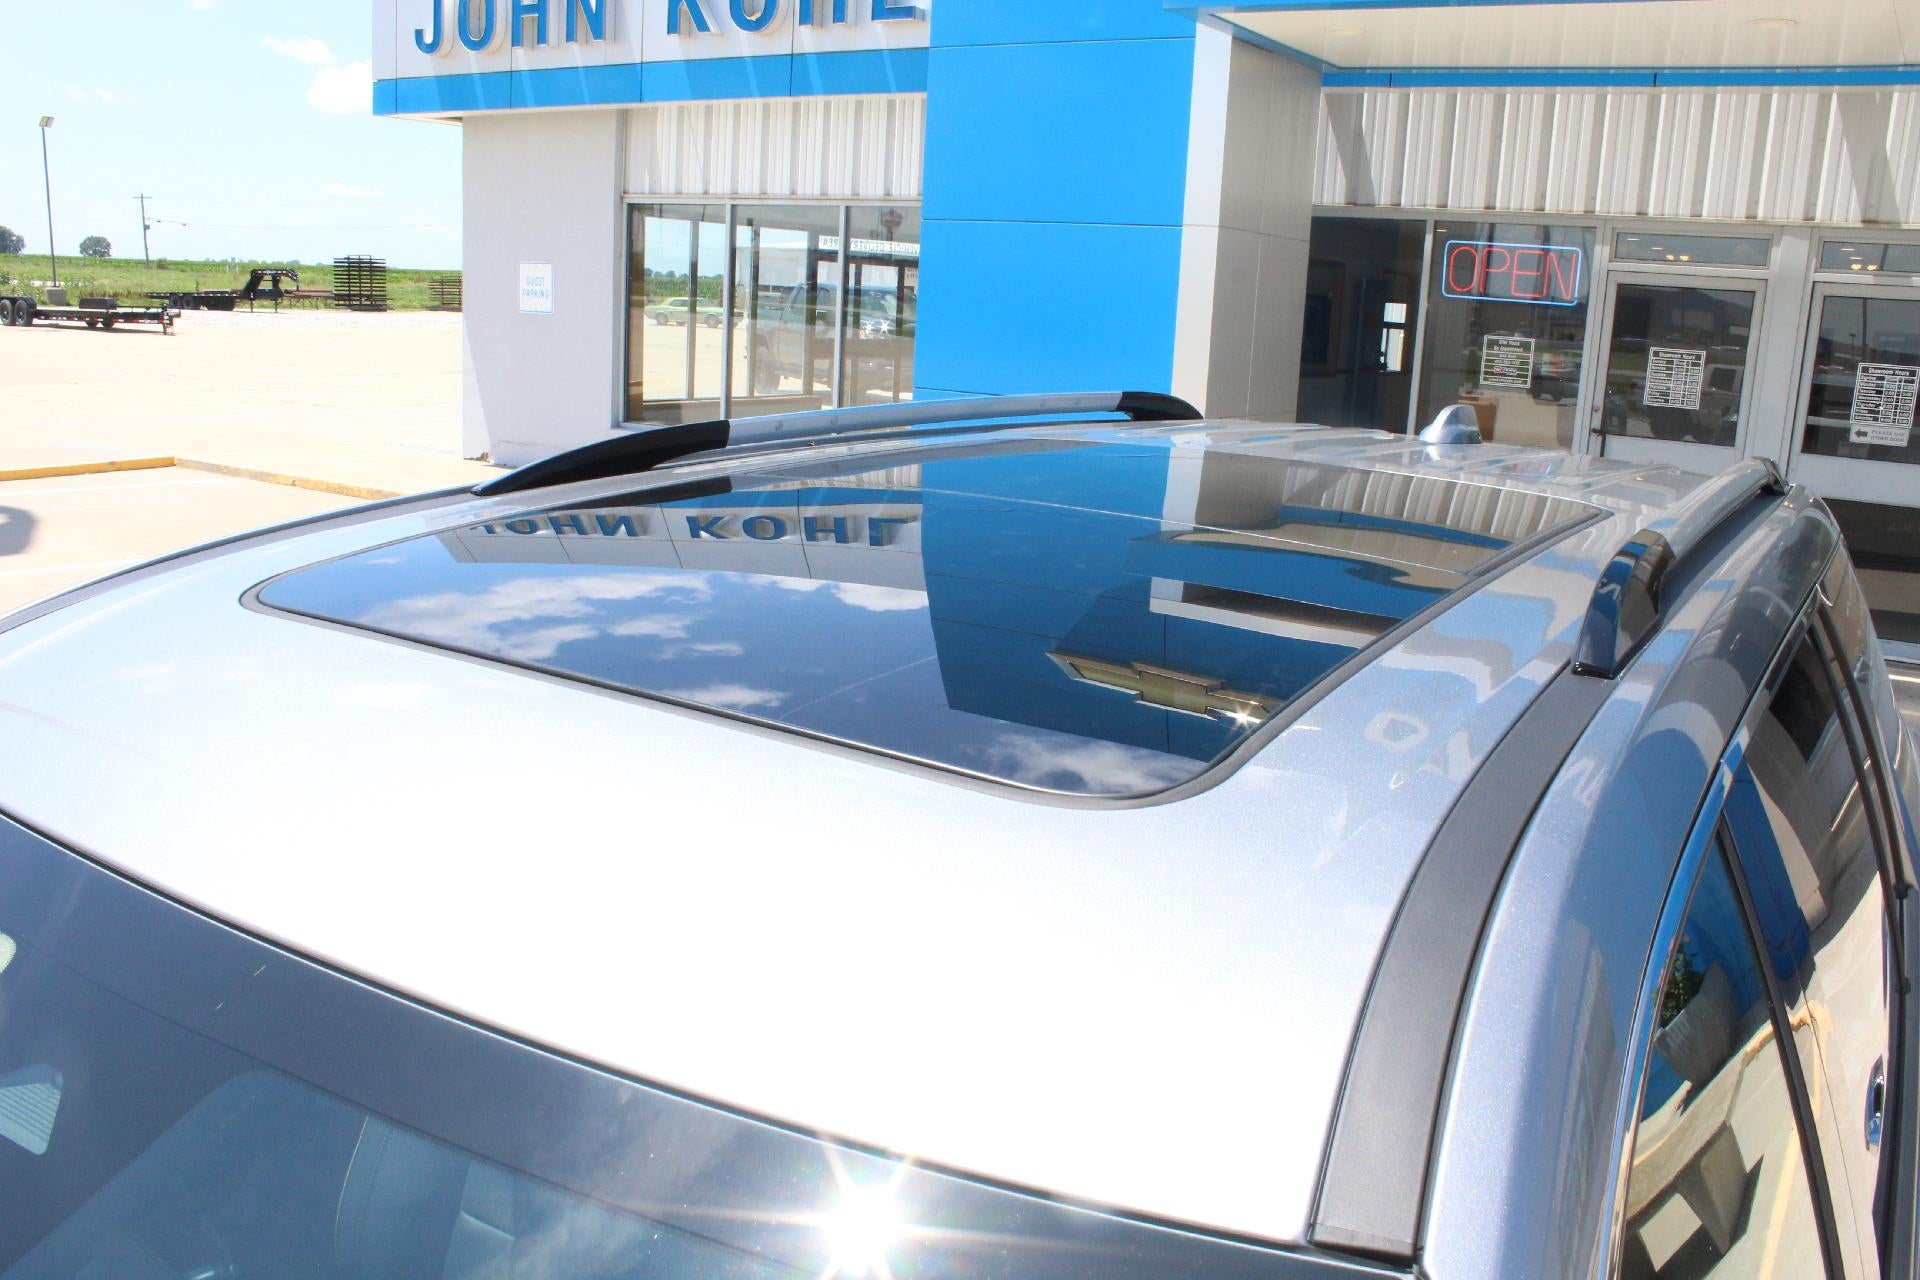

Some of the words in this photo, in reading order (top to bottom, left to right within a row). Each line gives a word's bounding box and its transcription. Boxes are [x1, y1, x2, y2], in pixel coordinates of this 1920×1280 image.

[1449, 246, 1577, 300] OPEN
[526, 276, 545, 287] GUEST
[1868, 367, 1894, 375] Showroom
